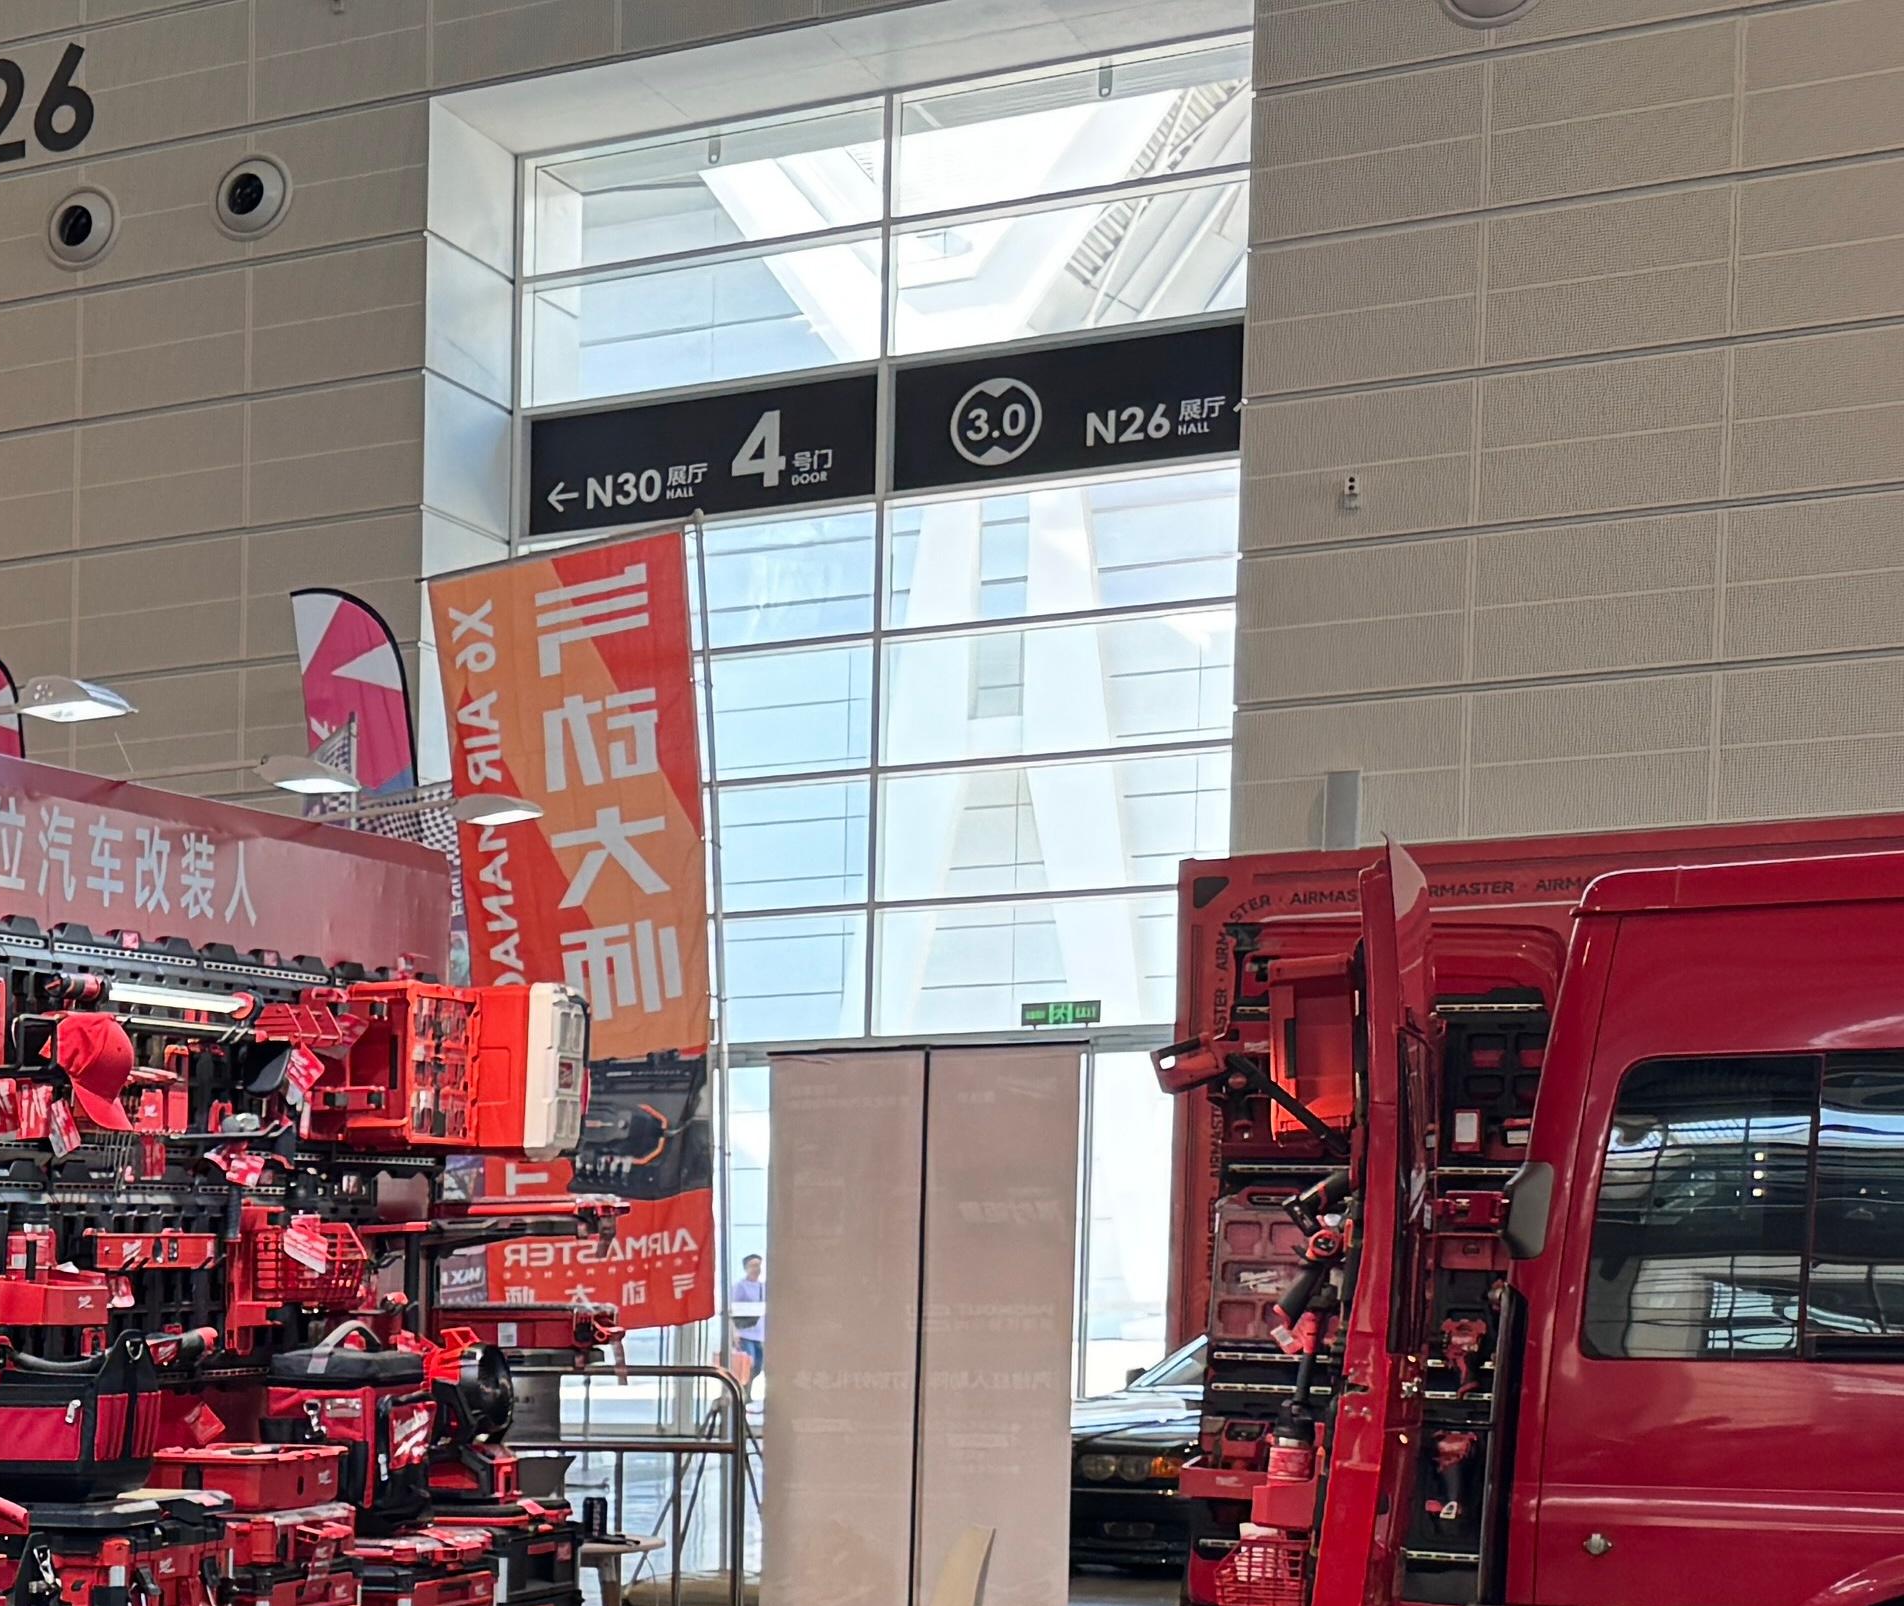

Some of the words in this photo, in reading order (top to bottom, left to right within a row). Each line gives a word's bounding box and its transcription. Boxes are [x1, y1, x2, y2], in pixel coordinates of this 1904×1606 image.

[966, 401, 1028, 440] 3.0
[1178, 395, 1227, 423] 展厅
[1085, 403, 1171, 447] N26
[1177, 420, 1210, 436] HALL
[731, 410, 787, 488] 4
[792, 449, 833, 472] 号门
[666, 462, 709, 487] 展厅
[792, 470, 828, 487] DOOR
[586, 467, 662, 510] N30
[666, 484, 695, 500] HALL
[1290, 889, 1359, 905] AIRMAS
[1429, 881, 1514, 897] RMASTER
